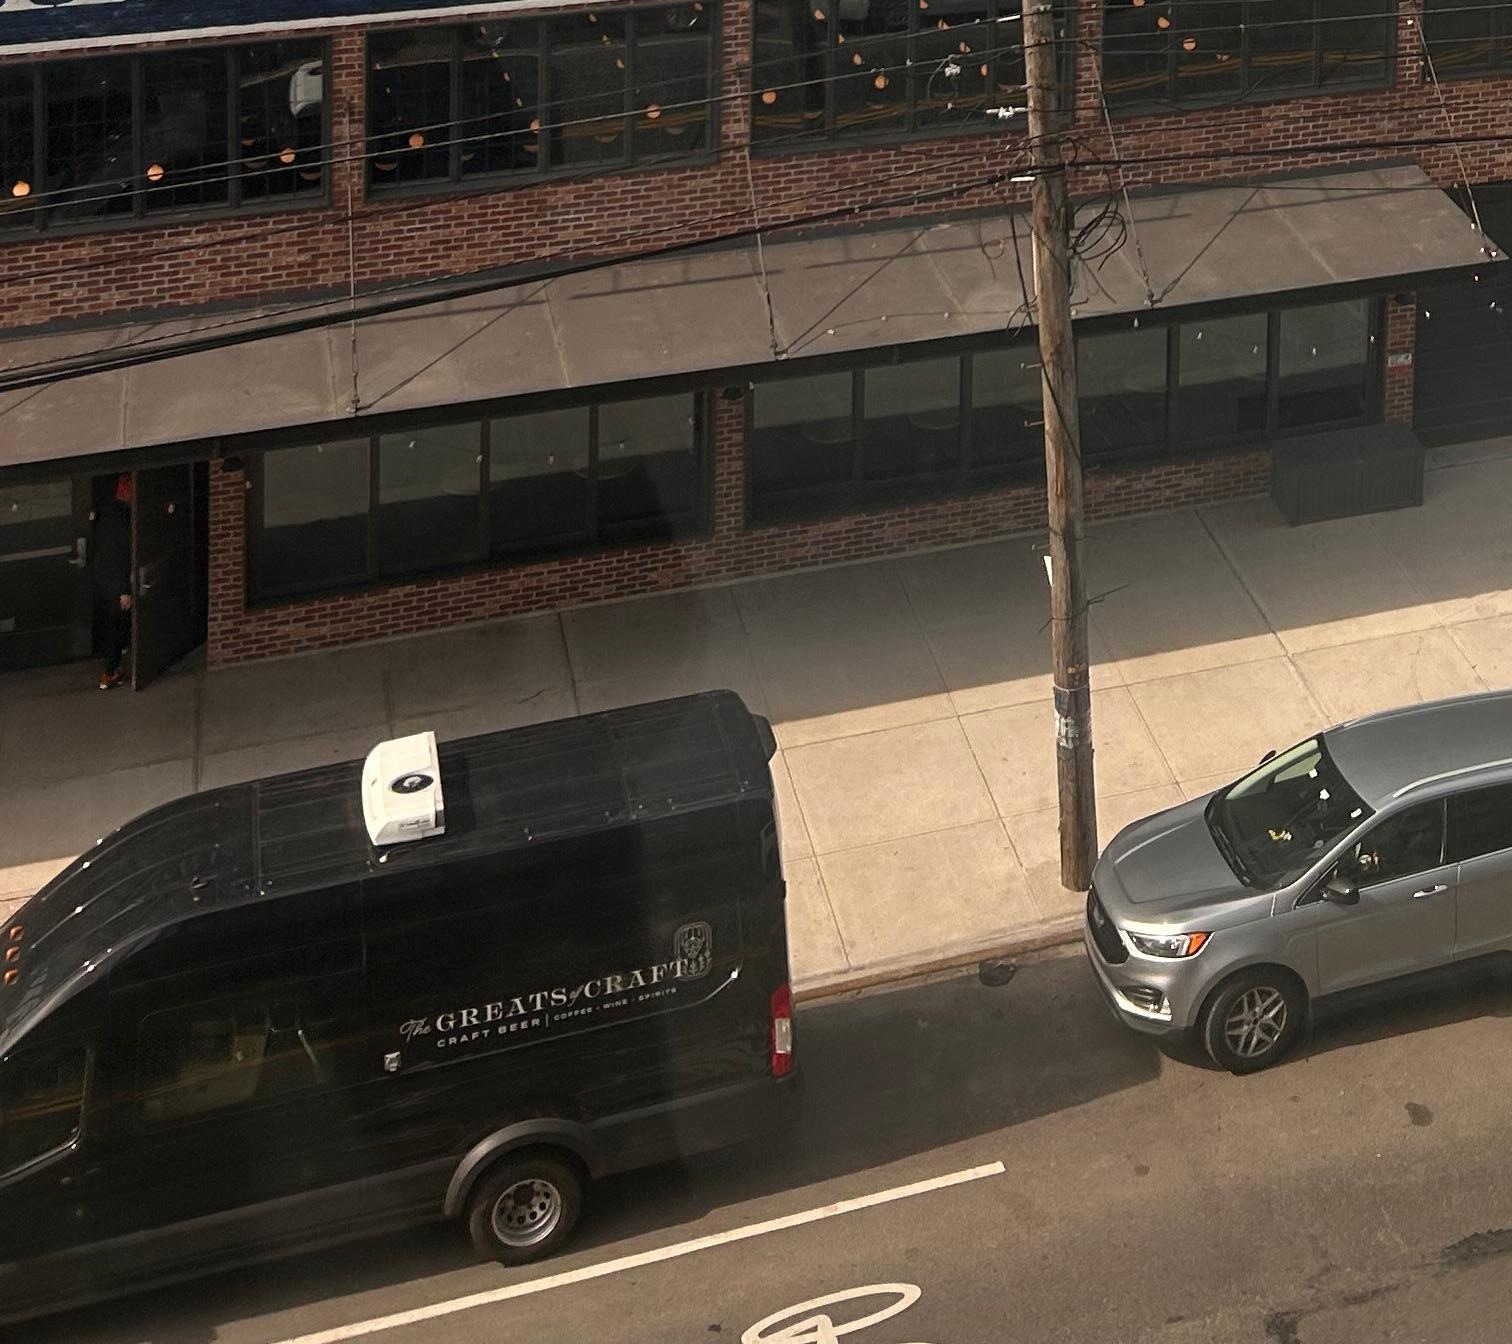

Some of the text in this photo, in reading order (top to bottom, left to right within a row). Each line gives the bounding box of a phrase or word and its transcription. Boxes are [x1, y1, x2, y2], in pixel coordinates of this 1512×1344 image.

[400, 1016, 432, 1043] The
[435, 987, 567, 1032] GREATS
[583, 958, 689, 998] CRAFT
[436, 1029, 490, 1047] CRAFT
[498, 1018, 540, 1034] BEER
[603, 998, 628, 1009] WINE
